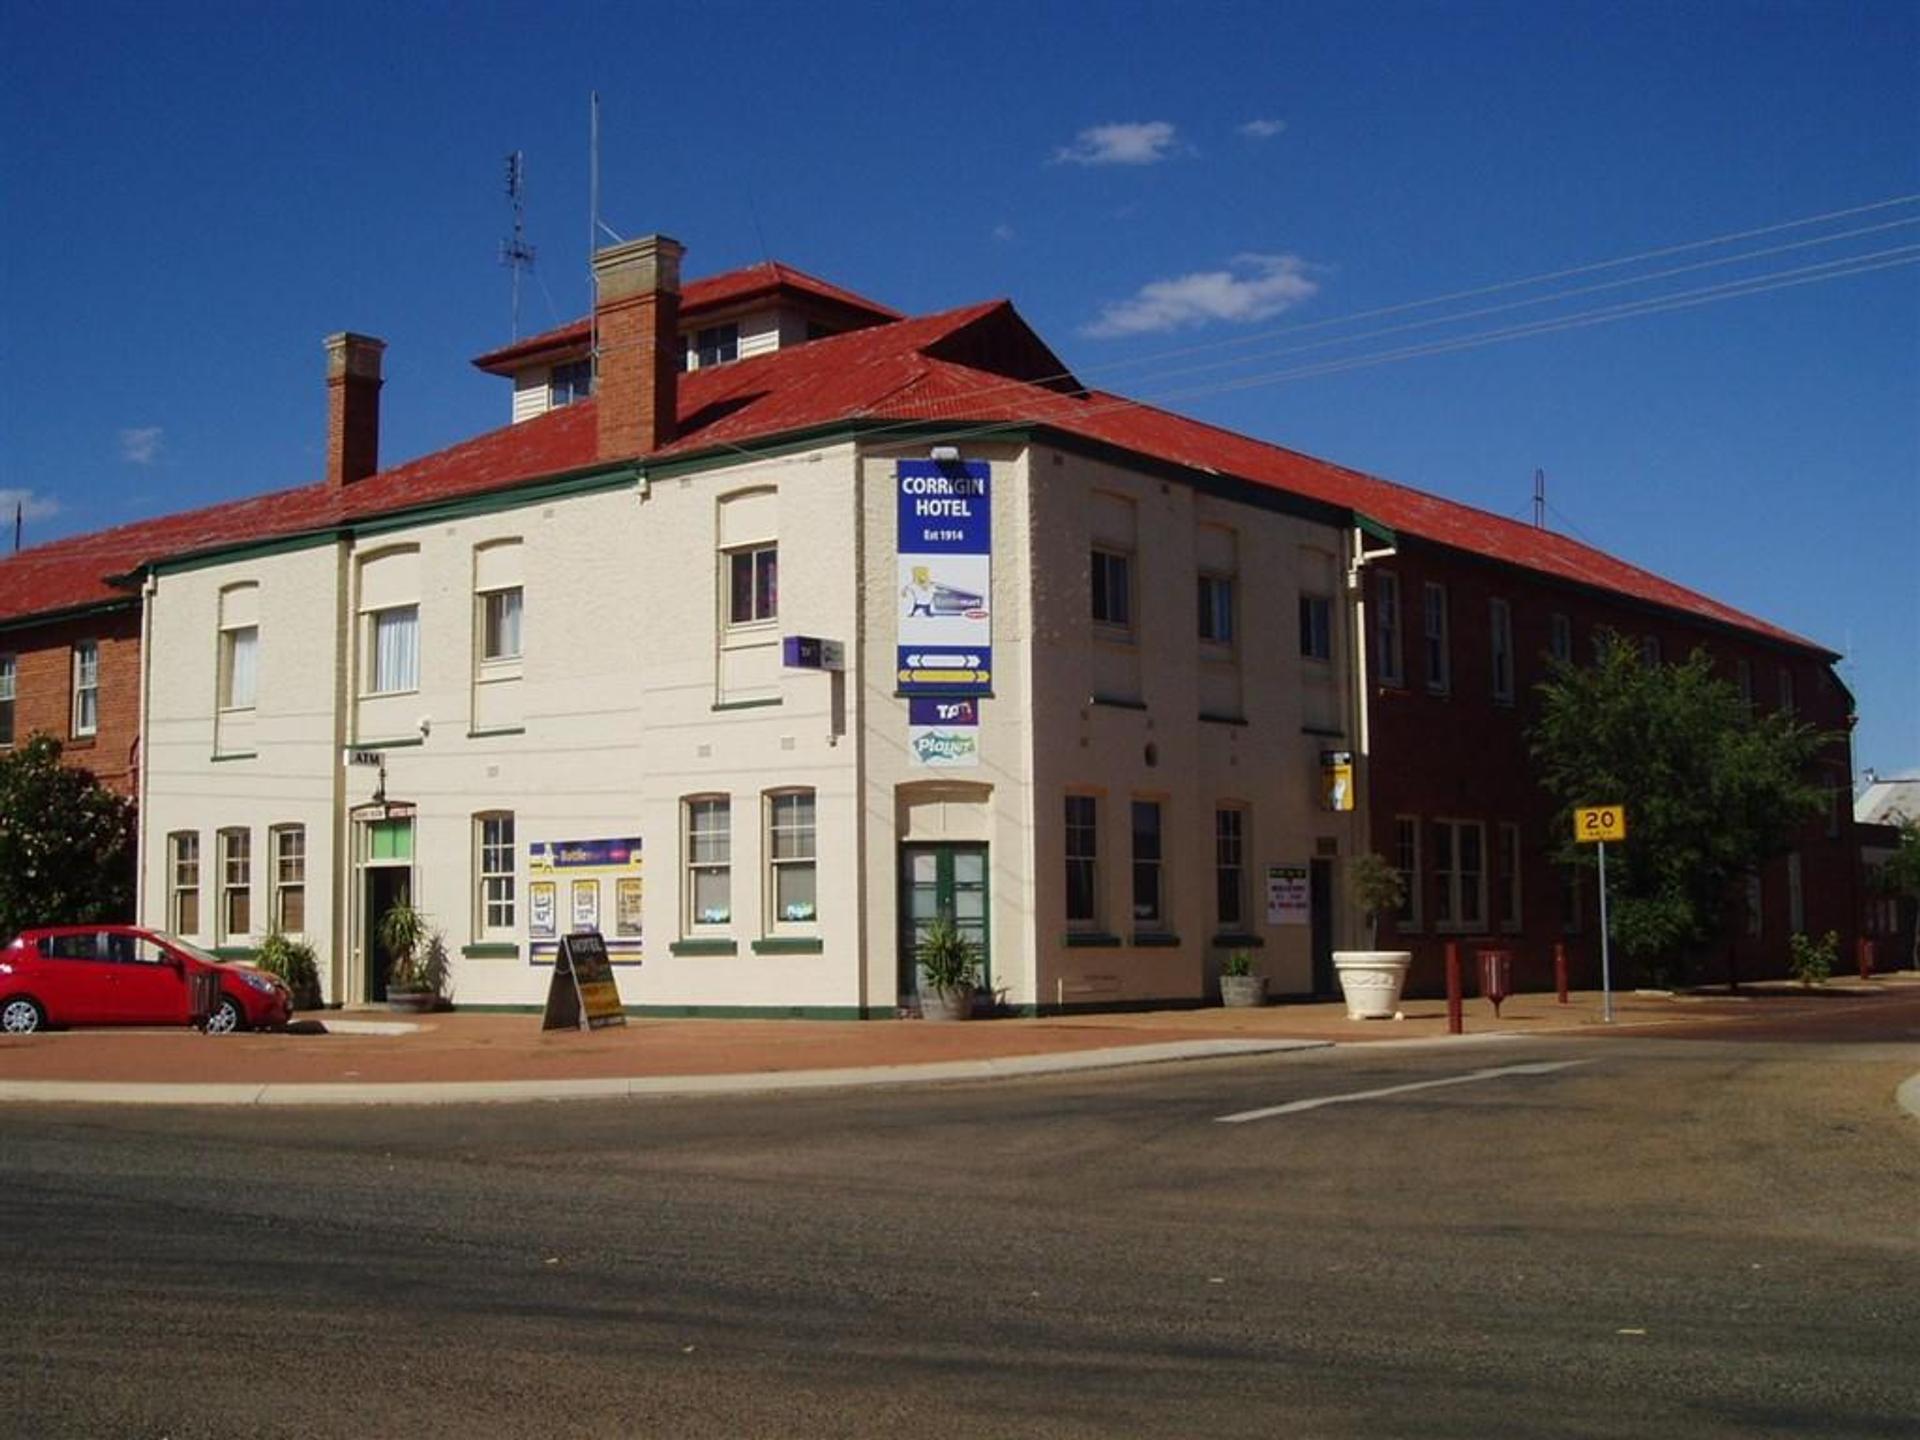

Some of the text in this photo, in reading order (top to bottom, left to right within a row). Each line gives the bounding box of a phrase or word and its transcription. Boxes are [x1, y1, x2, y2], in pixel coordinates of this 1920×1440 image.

[902, 477, 984, 494] CORRIGIN
[916, 499, 972, 516] HOTEL
[941, 529, 964, 541] 1914
[355, 752, 380, 766] ATM
[1585, 811, 1614, 828] 20
